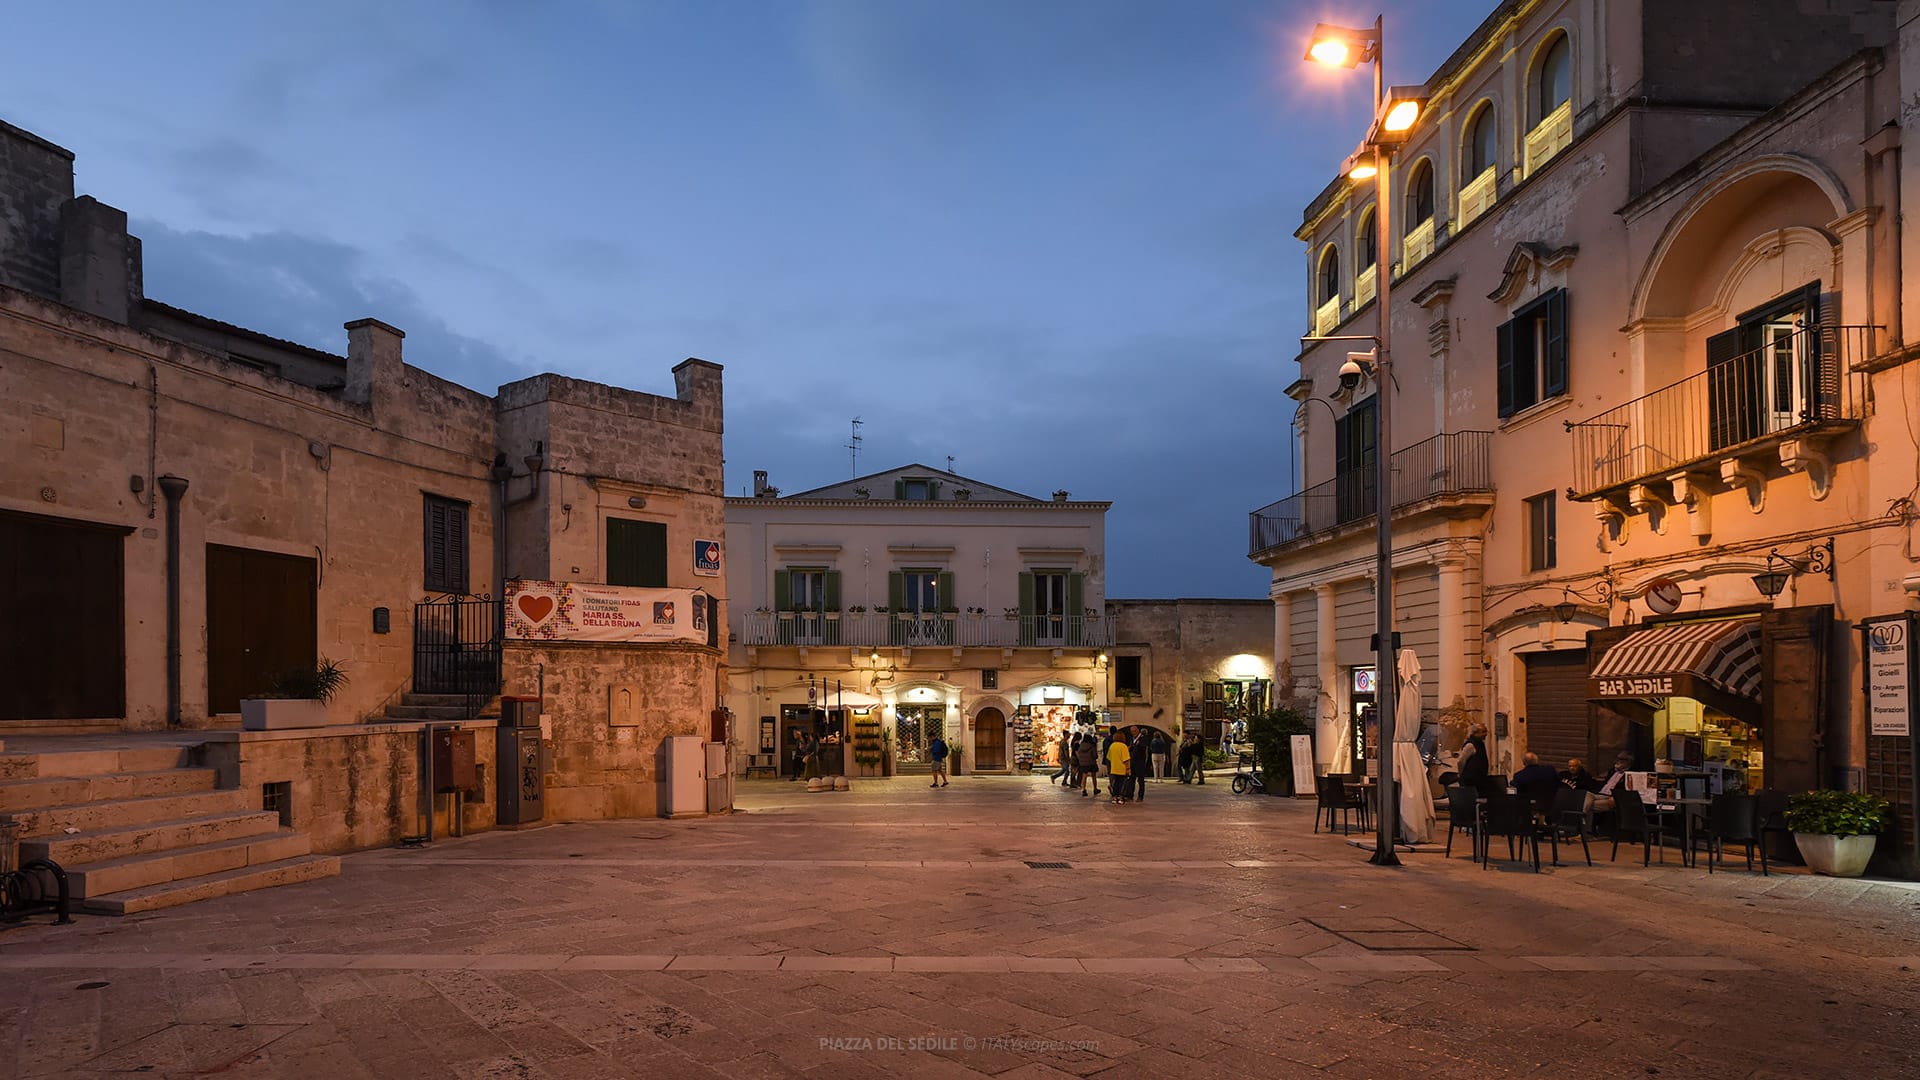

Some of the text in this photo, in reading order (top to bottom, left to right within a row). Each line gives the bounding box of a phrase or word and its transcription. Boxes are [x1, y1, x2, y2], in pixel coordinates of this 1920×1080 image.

[586, 598, 620, 606] DONATORI
[583, 611, 611, 619] MARIA
[583, 619, 641, 628] DELLA BRUNA
[1878, 669, 1899, 677] Gioielli
[1600, 678, 1672, 695] BAR SEDILE
